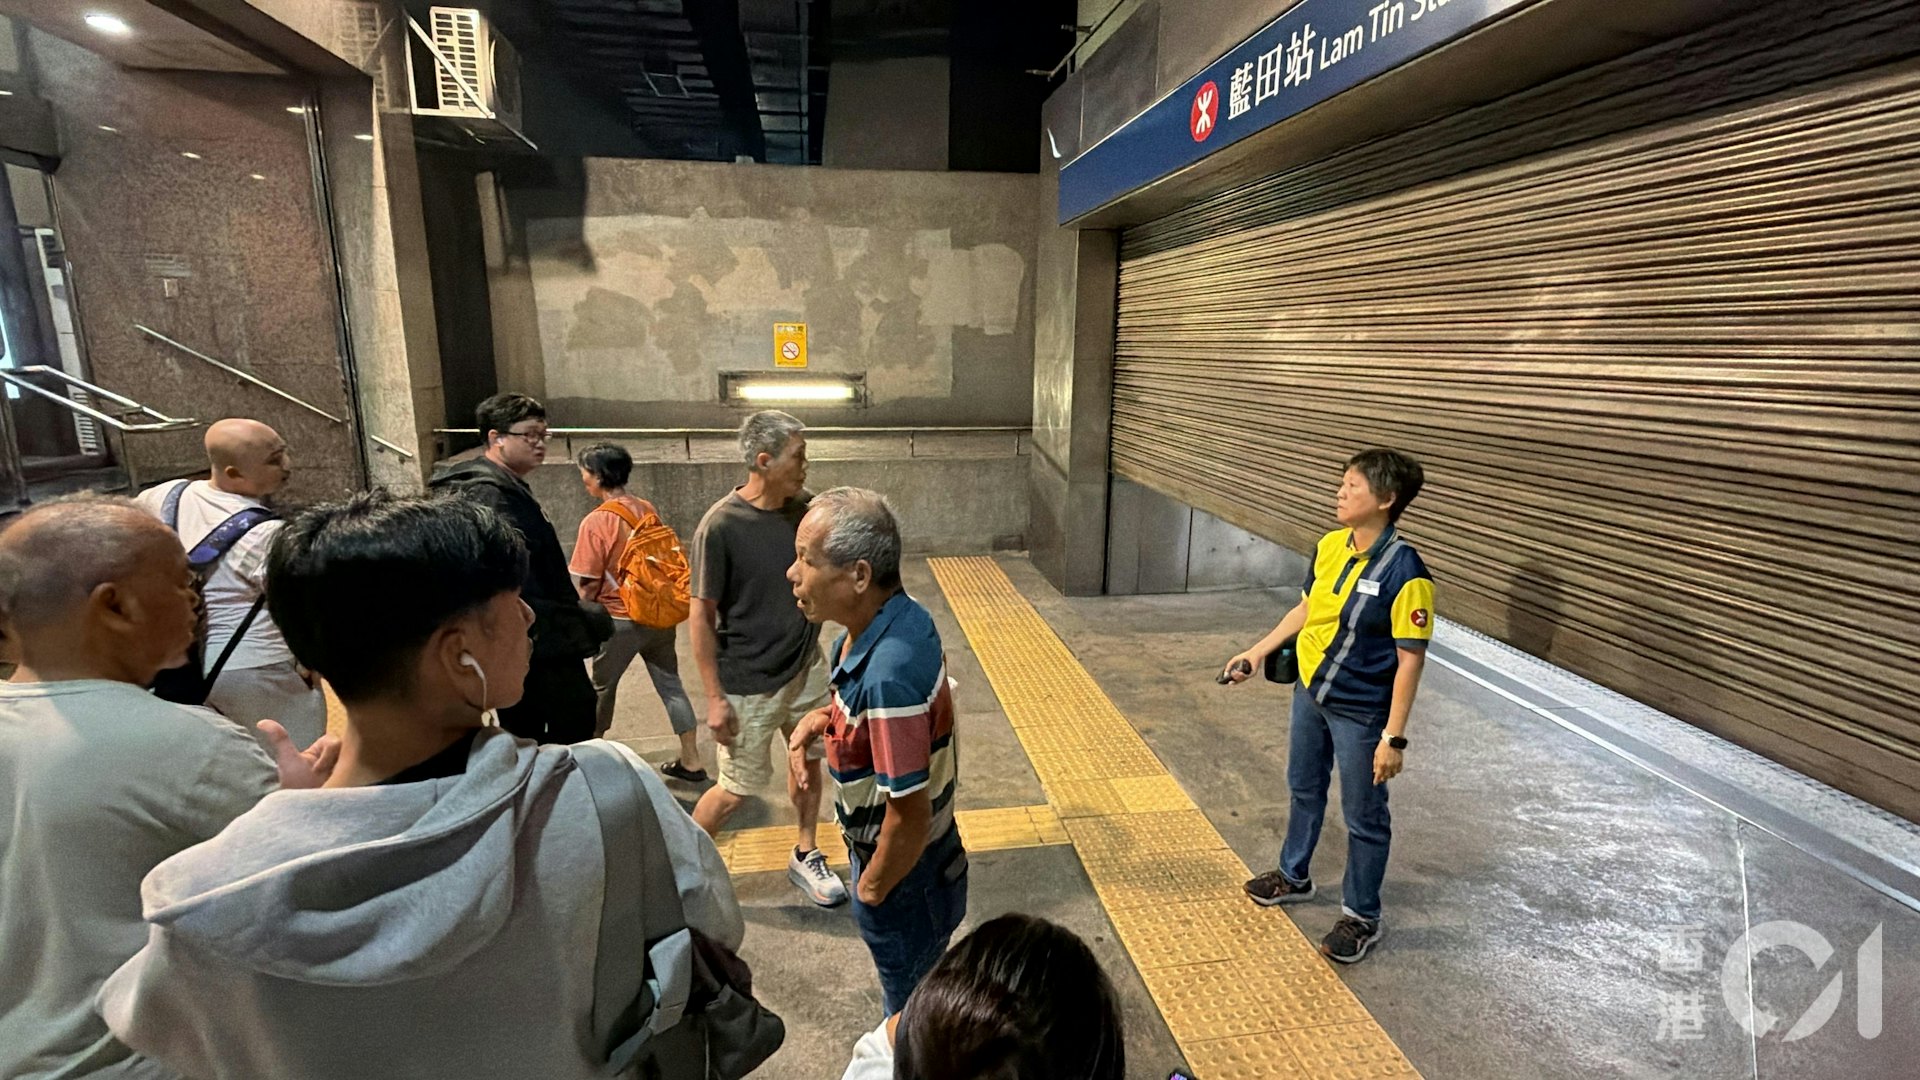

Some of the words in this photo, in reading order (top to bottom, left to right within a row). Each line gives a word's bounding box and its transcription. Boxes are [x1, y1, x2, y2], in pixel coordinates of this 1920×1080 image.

[1228, 23, 1316, 120] 藍田站
[1319, 25, 1364, 70] Lam
[1368, 0, 1404, 43] Tin
